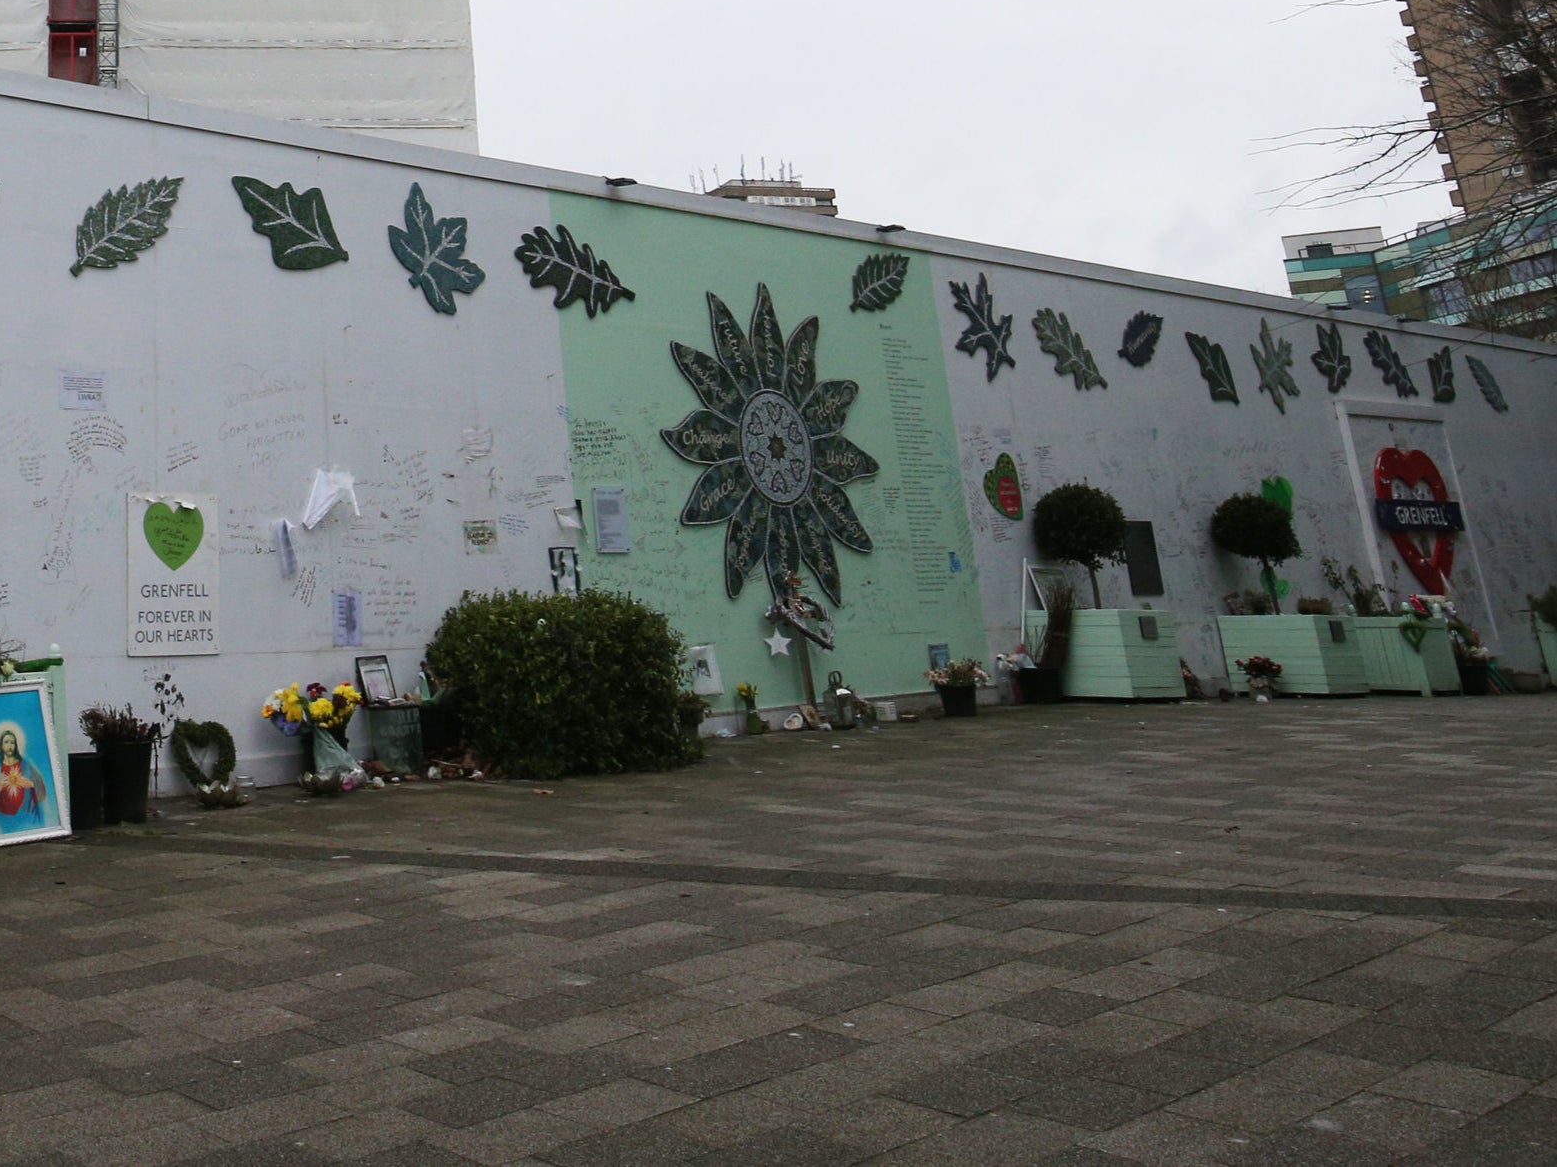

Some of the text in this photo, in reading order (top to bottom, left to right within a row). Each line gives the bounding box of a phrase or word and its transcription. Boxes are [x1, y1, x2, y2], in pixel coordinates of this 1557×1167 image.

[717, 319, 750, 378] Future
[764, 312, 779, 379] Forever
[789, 338, 810, 385] Love
[815, 395, 845, 423] Hope
[682, 430, 733, 453] Change
[826, 449, 862, 473] Unity
[699, 476, 737, 513] Grace
[1395, 506, 1448, 527] GRENFELL
[140, 584, 209, 599] GRENFELL
[137, 610, 212, 624] FOREVER IN
[134, 629, 214, 644] OUR HEARTS
